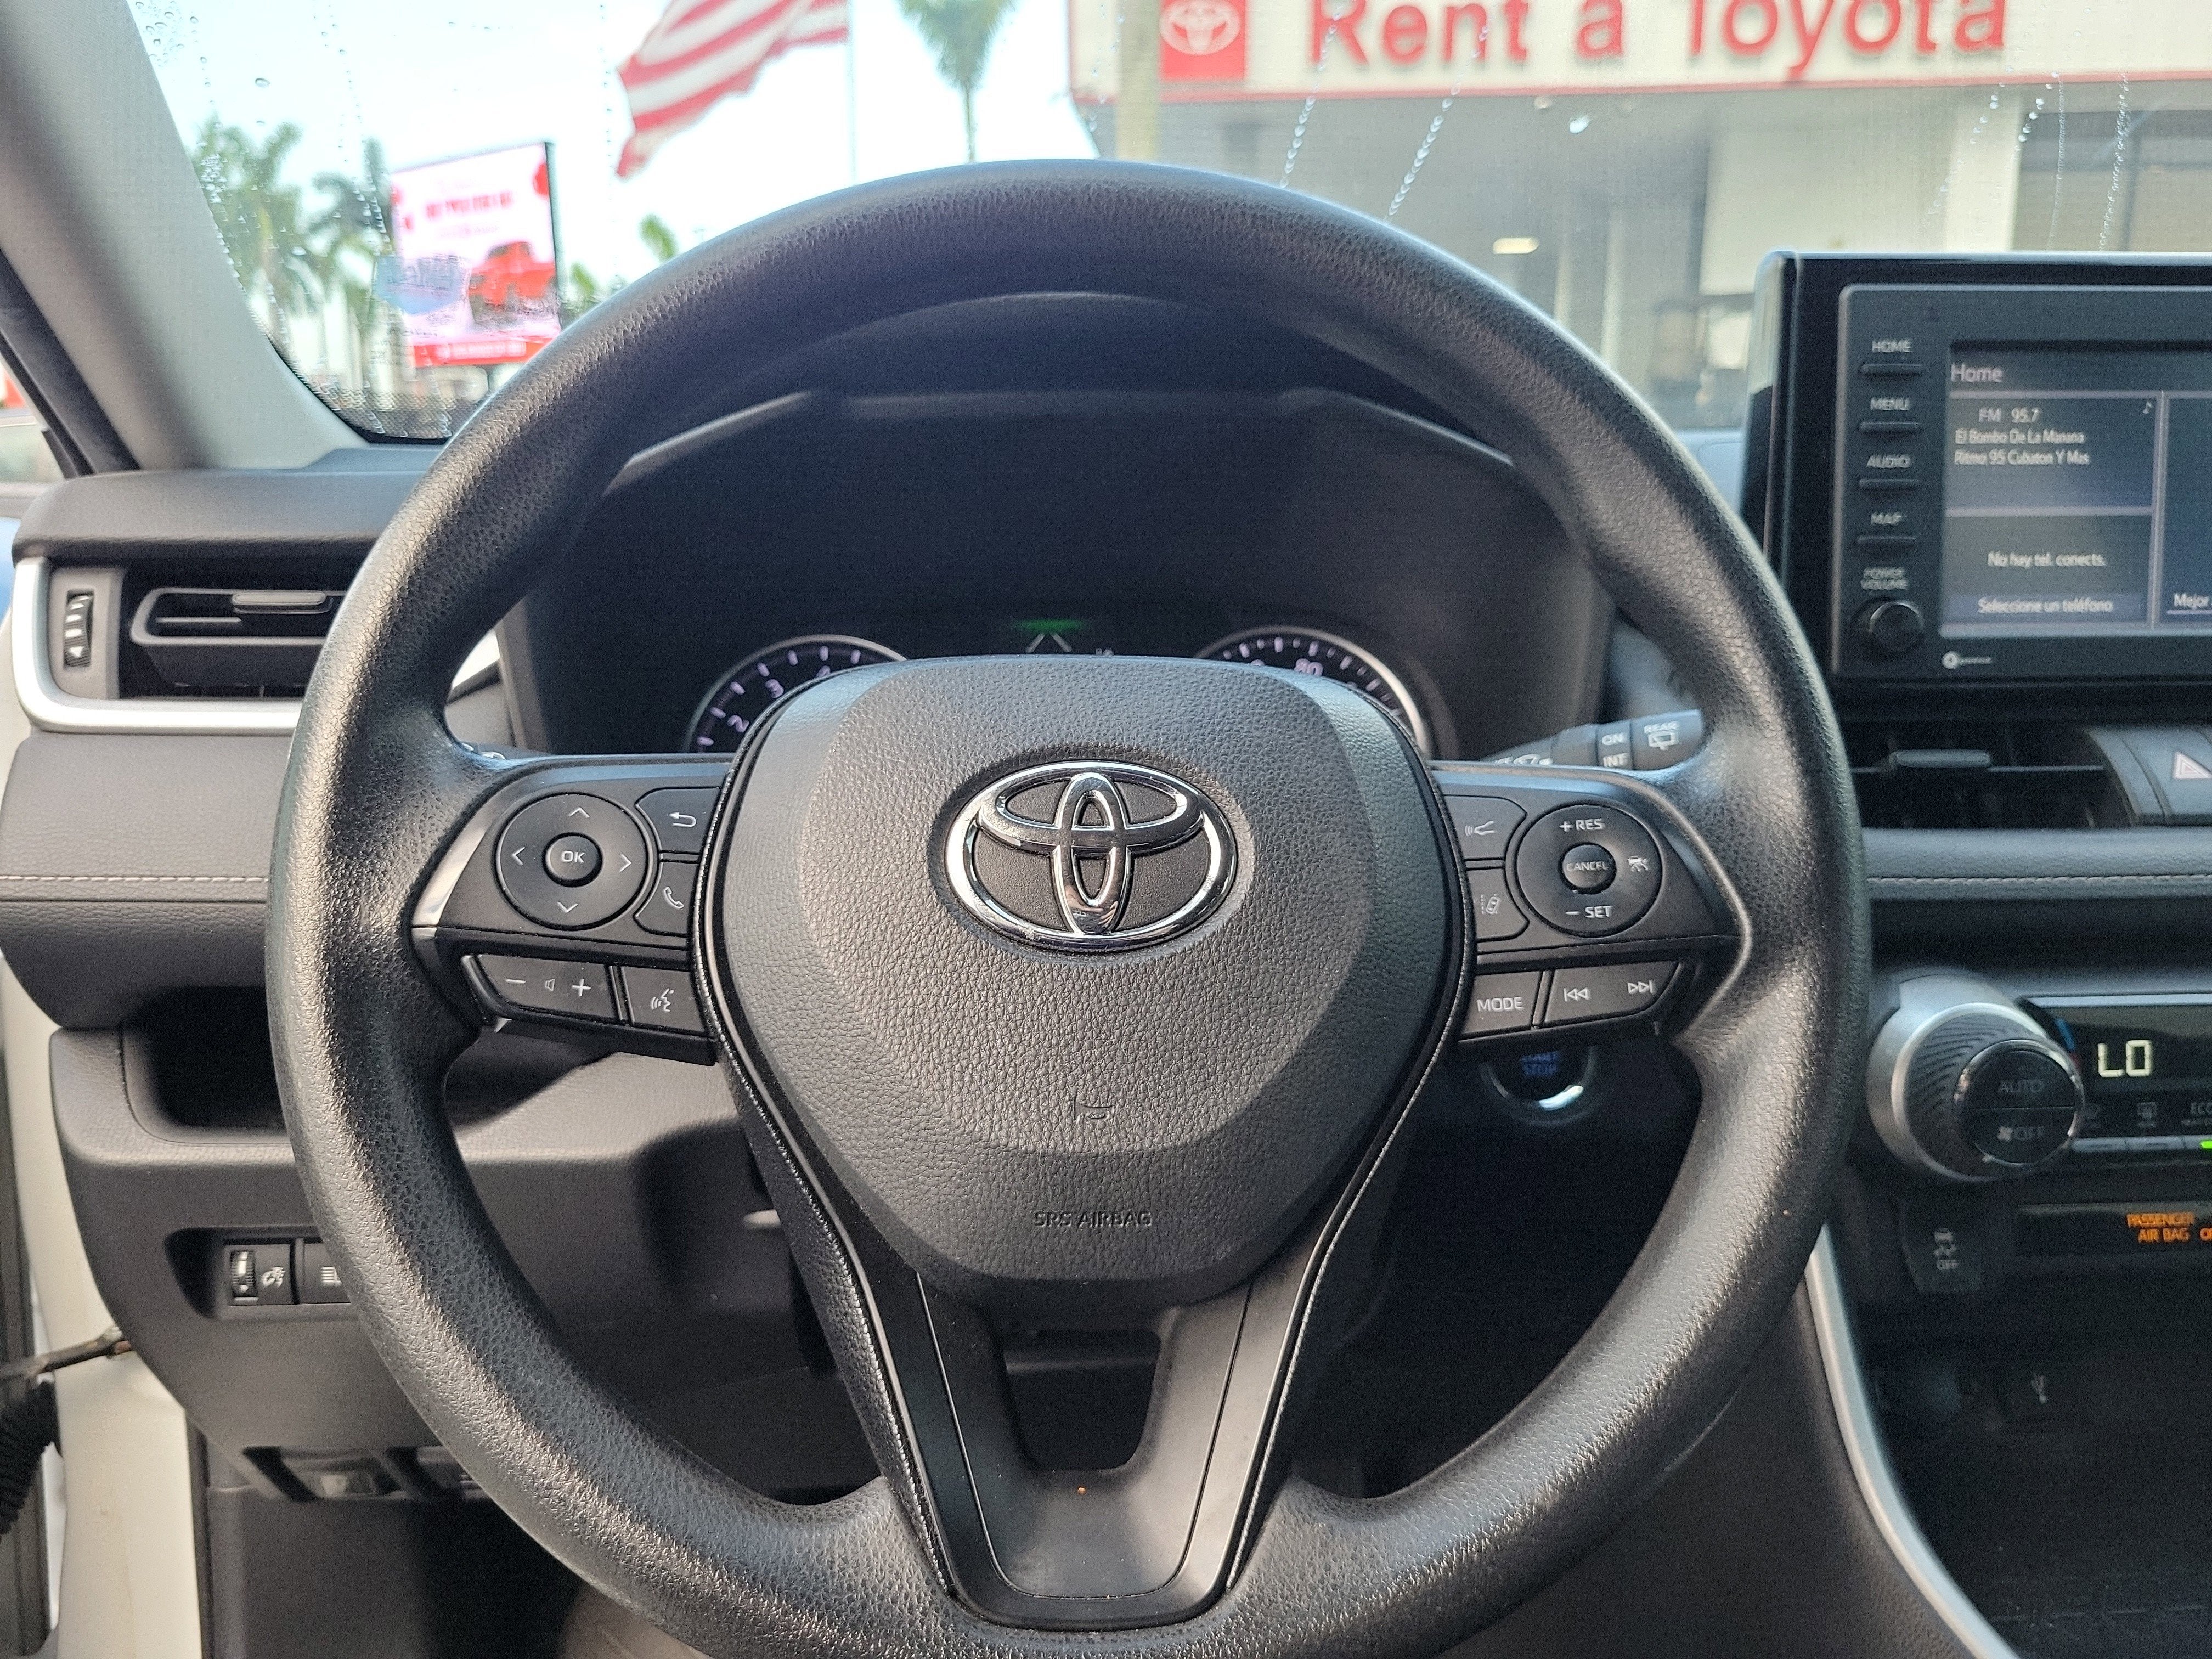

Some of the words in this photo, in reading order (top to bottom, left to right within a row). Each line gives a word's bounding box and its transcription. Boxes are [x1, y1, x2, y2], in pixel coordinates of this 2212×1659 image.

[1310, 0, 1529, 65] Rent
[1573, 0, 1624, 55] a
[1689, 0, 2005, 80] Toyota
[1871, 339, 1912, 352] HOME
[1950, 362, 2003, 382] Home
[1870, 397, 1910, 411] MENU
[1978, 408, 2001, 422] FM
[1955, 428, 1967, 444] El
[1968, 428, 2008, 444] Bombo
[2009, 428, 2027, 444] De
[2027, 428, 2041, 443] La
[1866, 454, 1910, 468] AUDIO
[1954, 449, 1988, 465] Ritmo
[1989, 449, 2006, 465] 95
[2055, 449, 2067, 464] Y
[1988, 551, 2009, 567] No
[2010, 551, 2033, 569] hay
[1978, 597, 2043, 614] Seleccione
[2044, 601, 2061, 613] un
[2174, 592, 2209, 610] Mejor
[1601, 733, 1626, 746] ON
[1602, 753, 1629, 767] INT
[1575, 817, 1605, 831] RES
[561, 850, 584, 864] OK
[1566, 861, 1609, 872] CANCEL
[1585, 905, 1612, 919] SET
[1477, 997, 1523, 1012] MODE
[1997, 1079, 2044, 1094] AUTO
[2014, 1126, 2046, 1141] OFF
[1034, 1211, 1071, 1227] SRS
[1077, 1211, 1152, 1228] AIRBAG
[2126, 1212, 2195, 1228] PASSENGER
[2138, 1228, 2159, 1243] AIR
[2163, 1227, 2189, 1242] BAG
[1936, 1259, 1959, 1271] OFF
